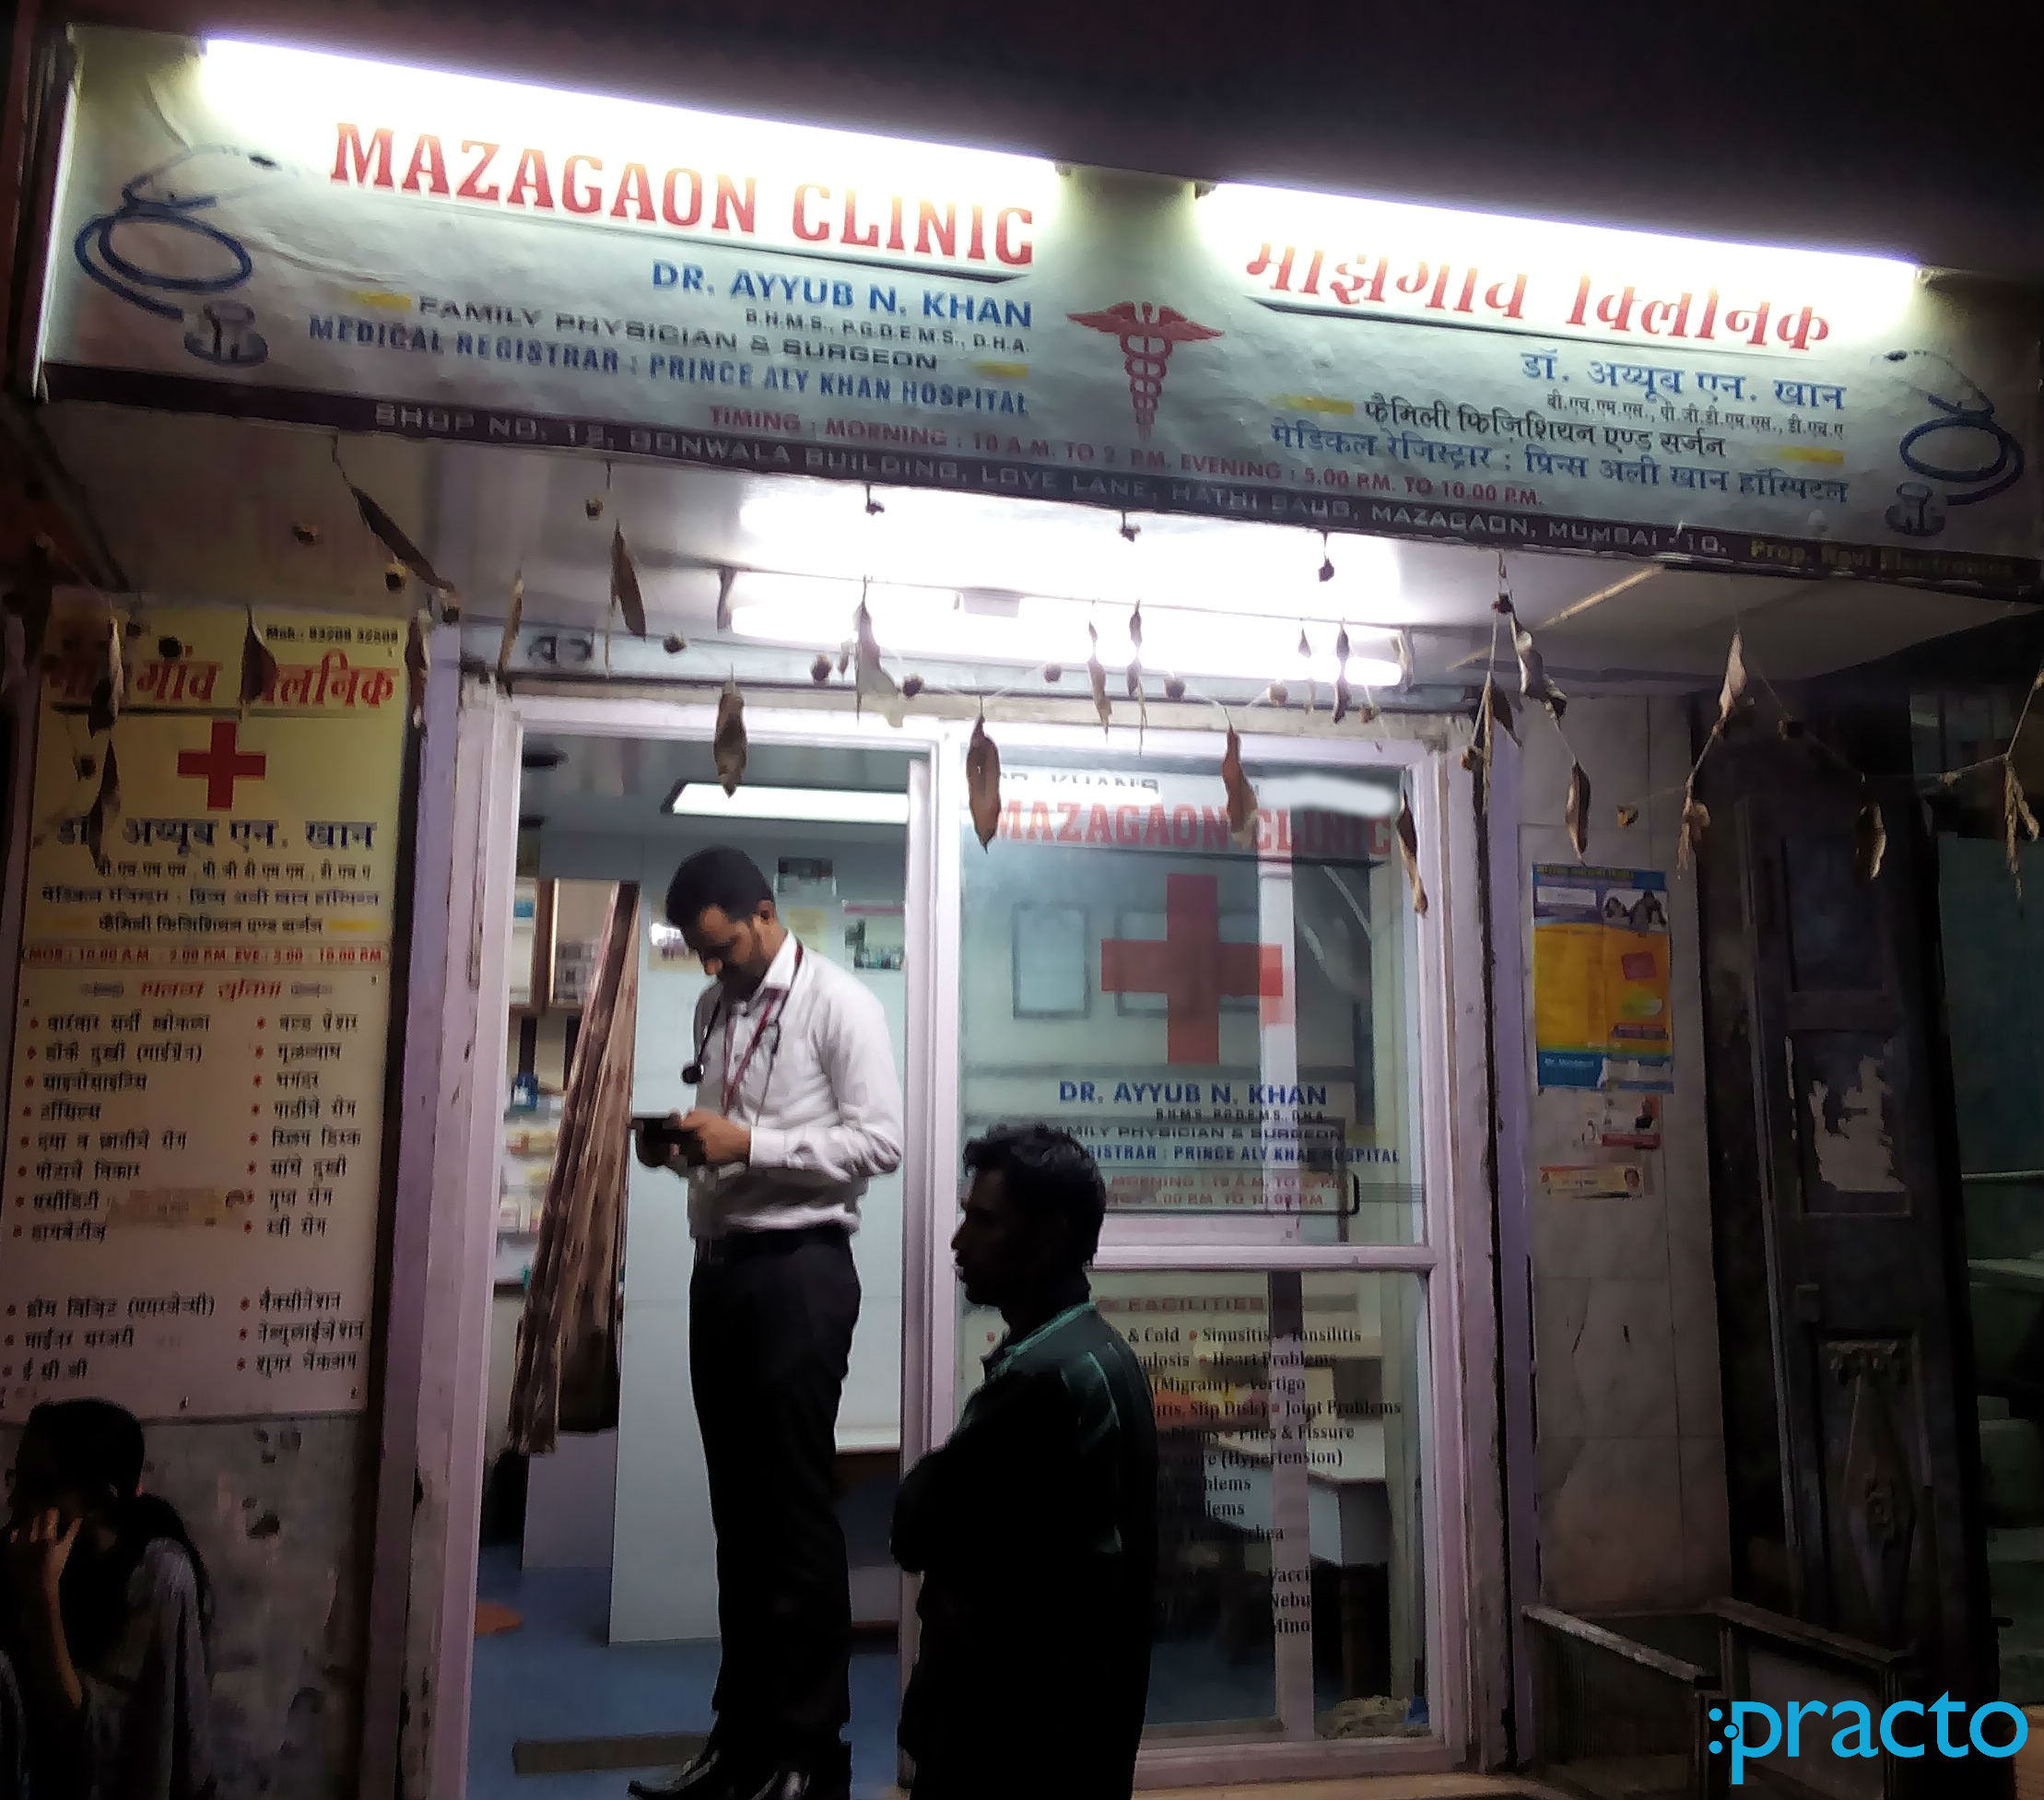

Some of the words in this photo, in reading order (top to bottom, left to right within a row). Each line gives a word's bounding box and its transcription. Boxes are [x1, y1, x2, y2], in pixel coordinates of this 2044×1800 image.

[329, 122, 757, 234] MAZAGAON
[791, 182, 1034, 267] CLINIC
[652, 259, 714, 296] DR.
[730, 268, 853, 309] AYYUB
[869, 283, 908, 317] N.
[922, 288, 1032, 330] KHAN
[418, 295, 542, 328] FAMILY
[555, 311, 737, 350] PHYSICIAN
[750, 335, 770, 355] &
[781, 337, 938, 371] SURGEON
[310, 314, 444, 356] MEDICAL
[457, 330, 619, 375] REGISTRAR
[649, 352, 755, 389] PRINCE
[764, 366, 810, 394] ALY
[819, 371, 892, 403] KHAN
[902, 380, 1030, 417] HOSPITAL
[1772, 378, 1848, 410] खान
[709, 405, 801, 432] TIMING
[825, 417, 948, 448] MORNING
[1064, 441, 1095, 462] TO
[1180, 453, 1283, 479] EVENING
[1404, 476, 1433, 496] TO
[1669, 465, 1731, 494] खान
[1370, 502, 1536, 538] MAZAGAON,
[997, 798, 1228, 850] MAZAGAON
[1060, 1080, 1104, 1104] DR.
[1112, 1081, 1202, 1105] AYYUB
[1211, 1083, 1239, 1105] N.
[1248, 1082, 1328, 1106] KHAN
[1117, 1126, 1226, 1141] PHYSICIAN
[1173, 1144, 1235, 1162] PRINCE
[1145, 1326, 1181, 1342] Cold
